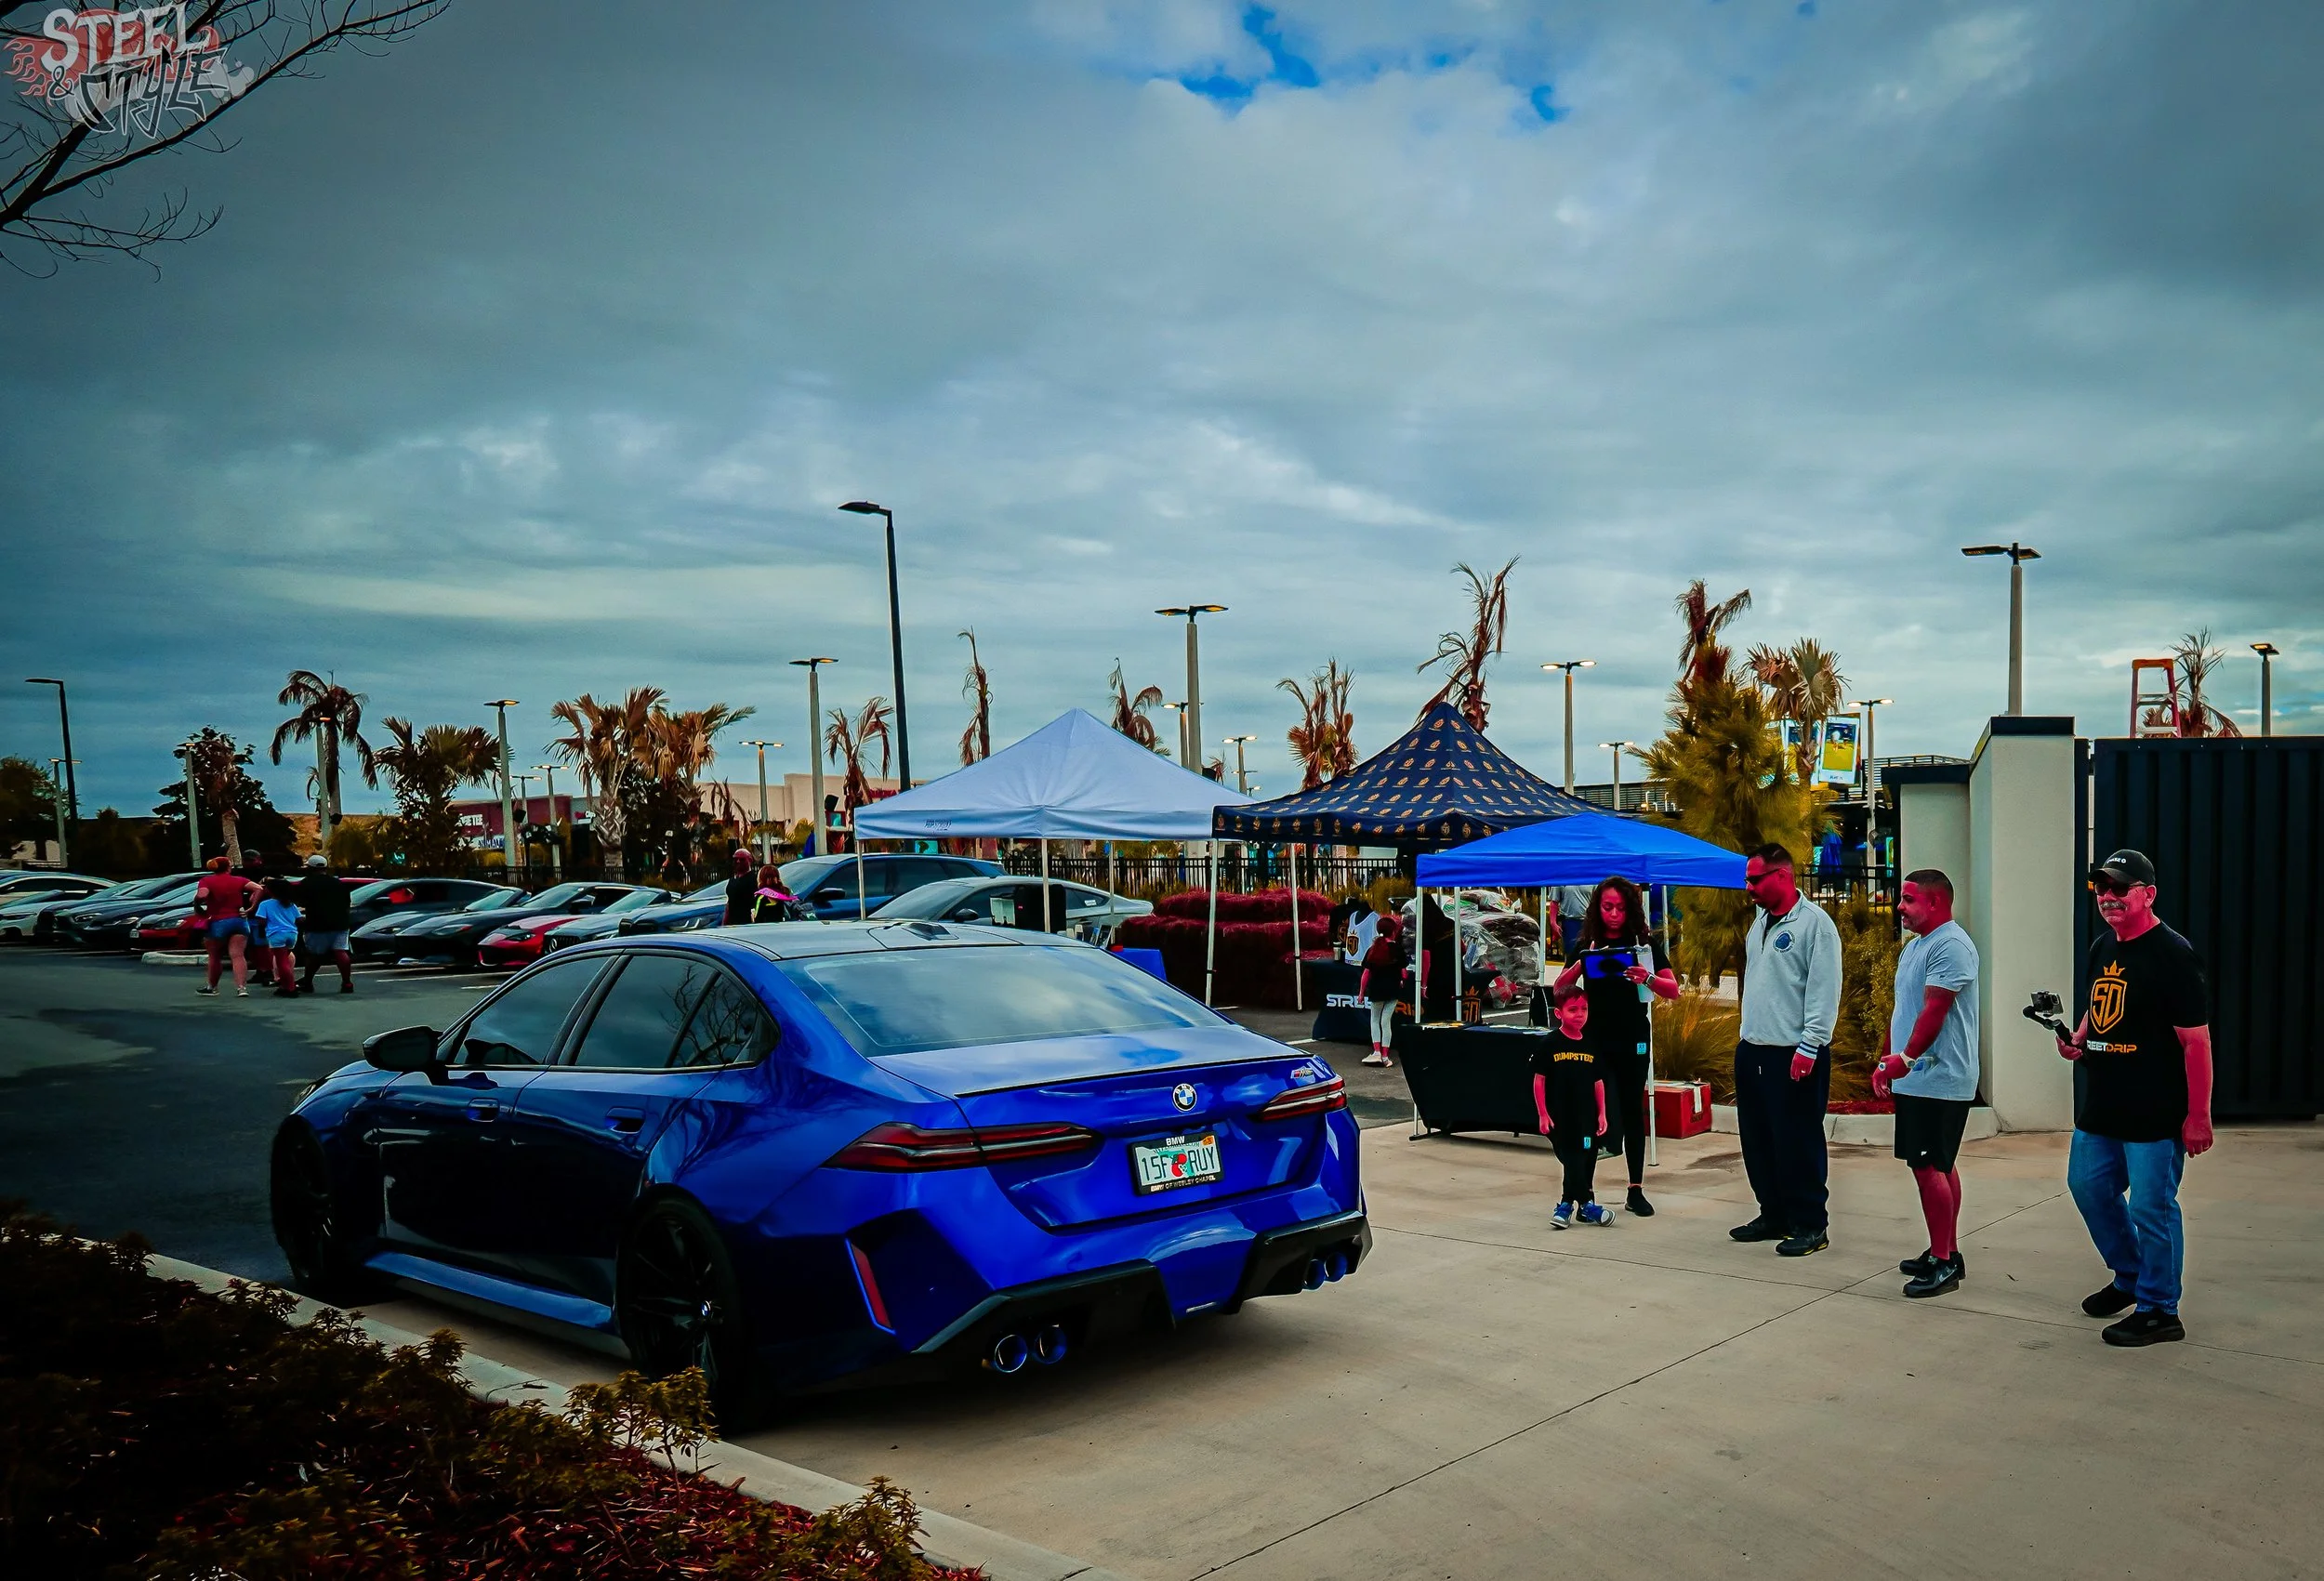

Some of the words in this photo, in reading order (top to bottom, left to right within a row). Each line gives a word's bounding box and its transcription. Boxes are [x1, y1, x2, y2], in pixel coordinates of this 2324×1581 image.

[2092, 983, 2122, 1028] SD
[2086, 1039, 2137, 1053] REETDRIP
[1166, 1136, 1185, 1146] BMW
[1187, 1146, 1215, 1174] RUY
